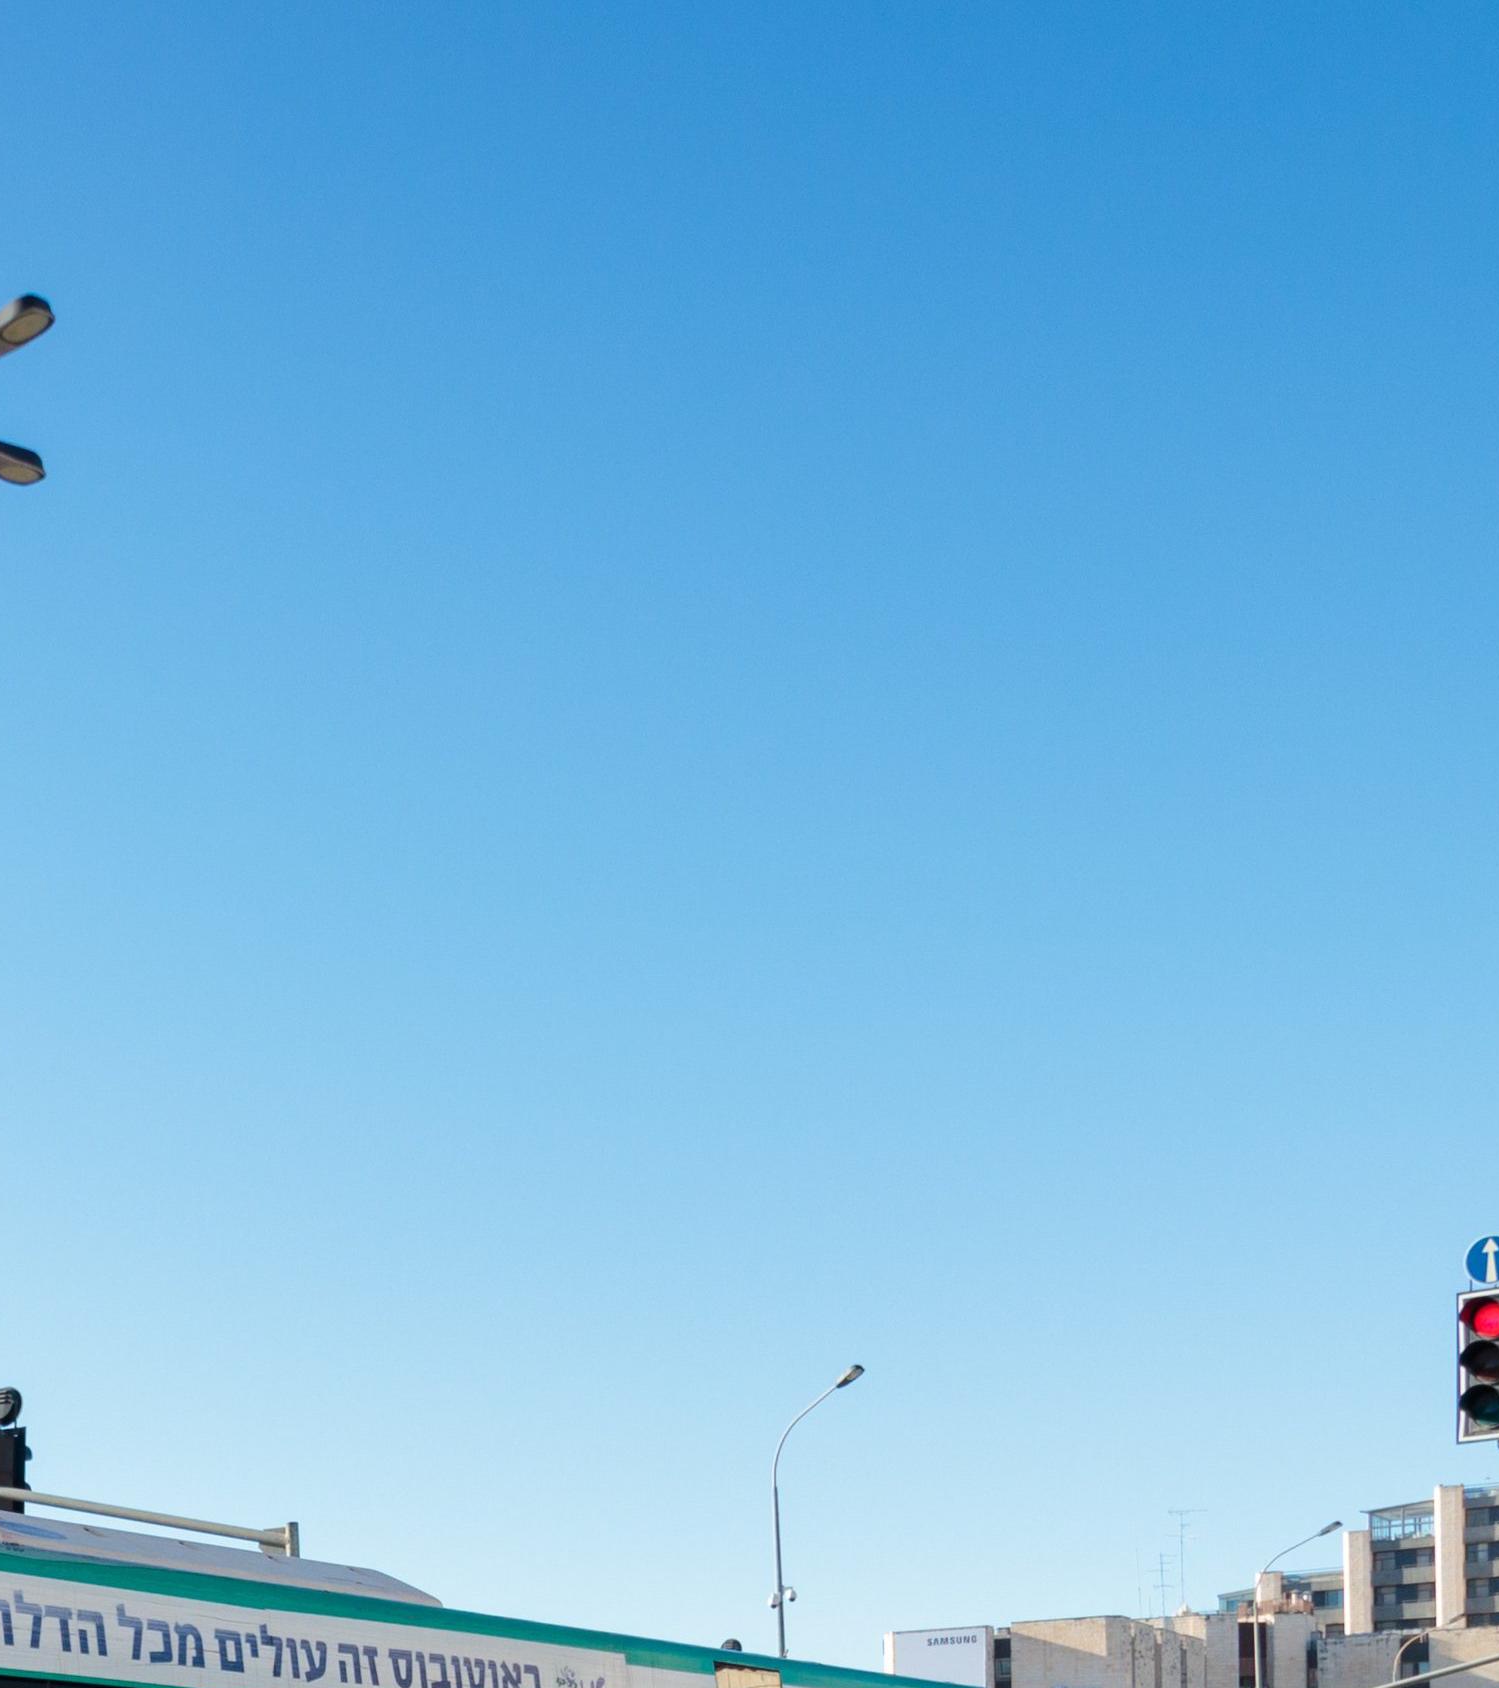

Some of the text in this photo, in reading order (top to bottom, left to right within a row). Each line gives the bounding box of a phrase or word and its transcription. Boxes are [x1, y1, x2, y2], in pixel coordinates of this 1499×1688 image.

[115, 1602, 204, 1668] מכל
[217, 1622, 328, 1682] עולים
[926, 1634, 978, 1647] SAMSUNG
[338, 1643, 379, 1685] זה
